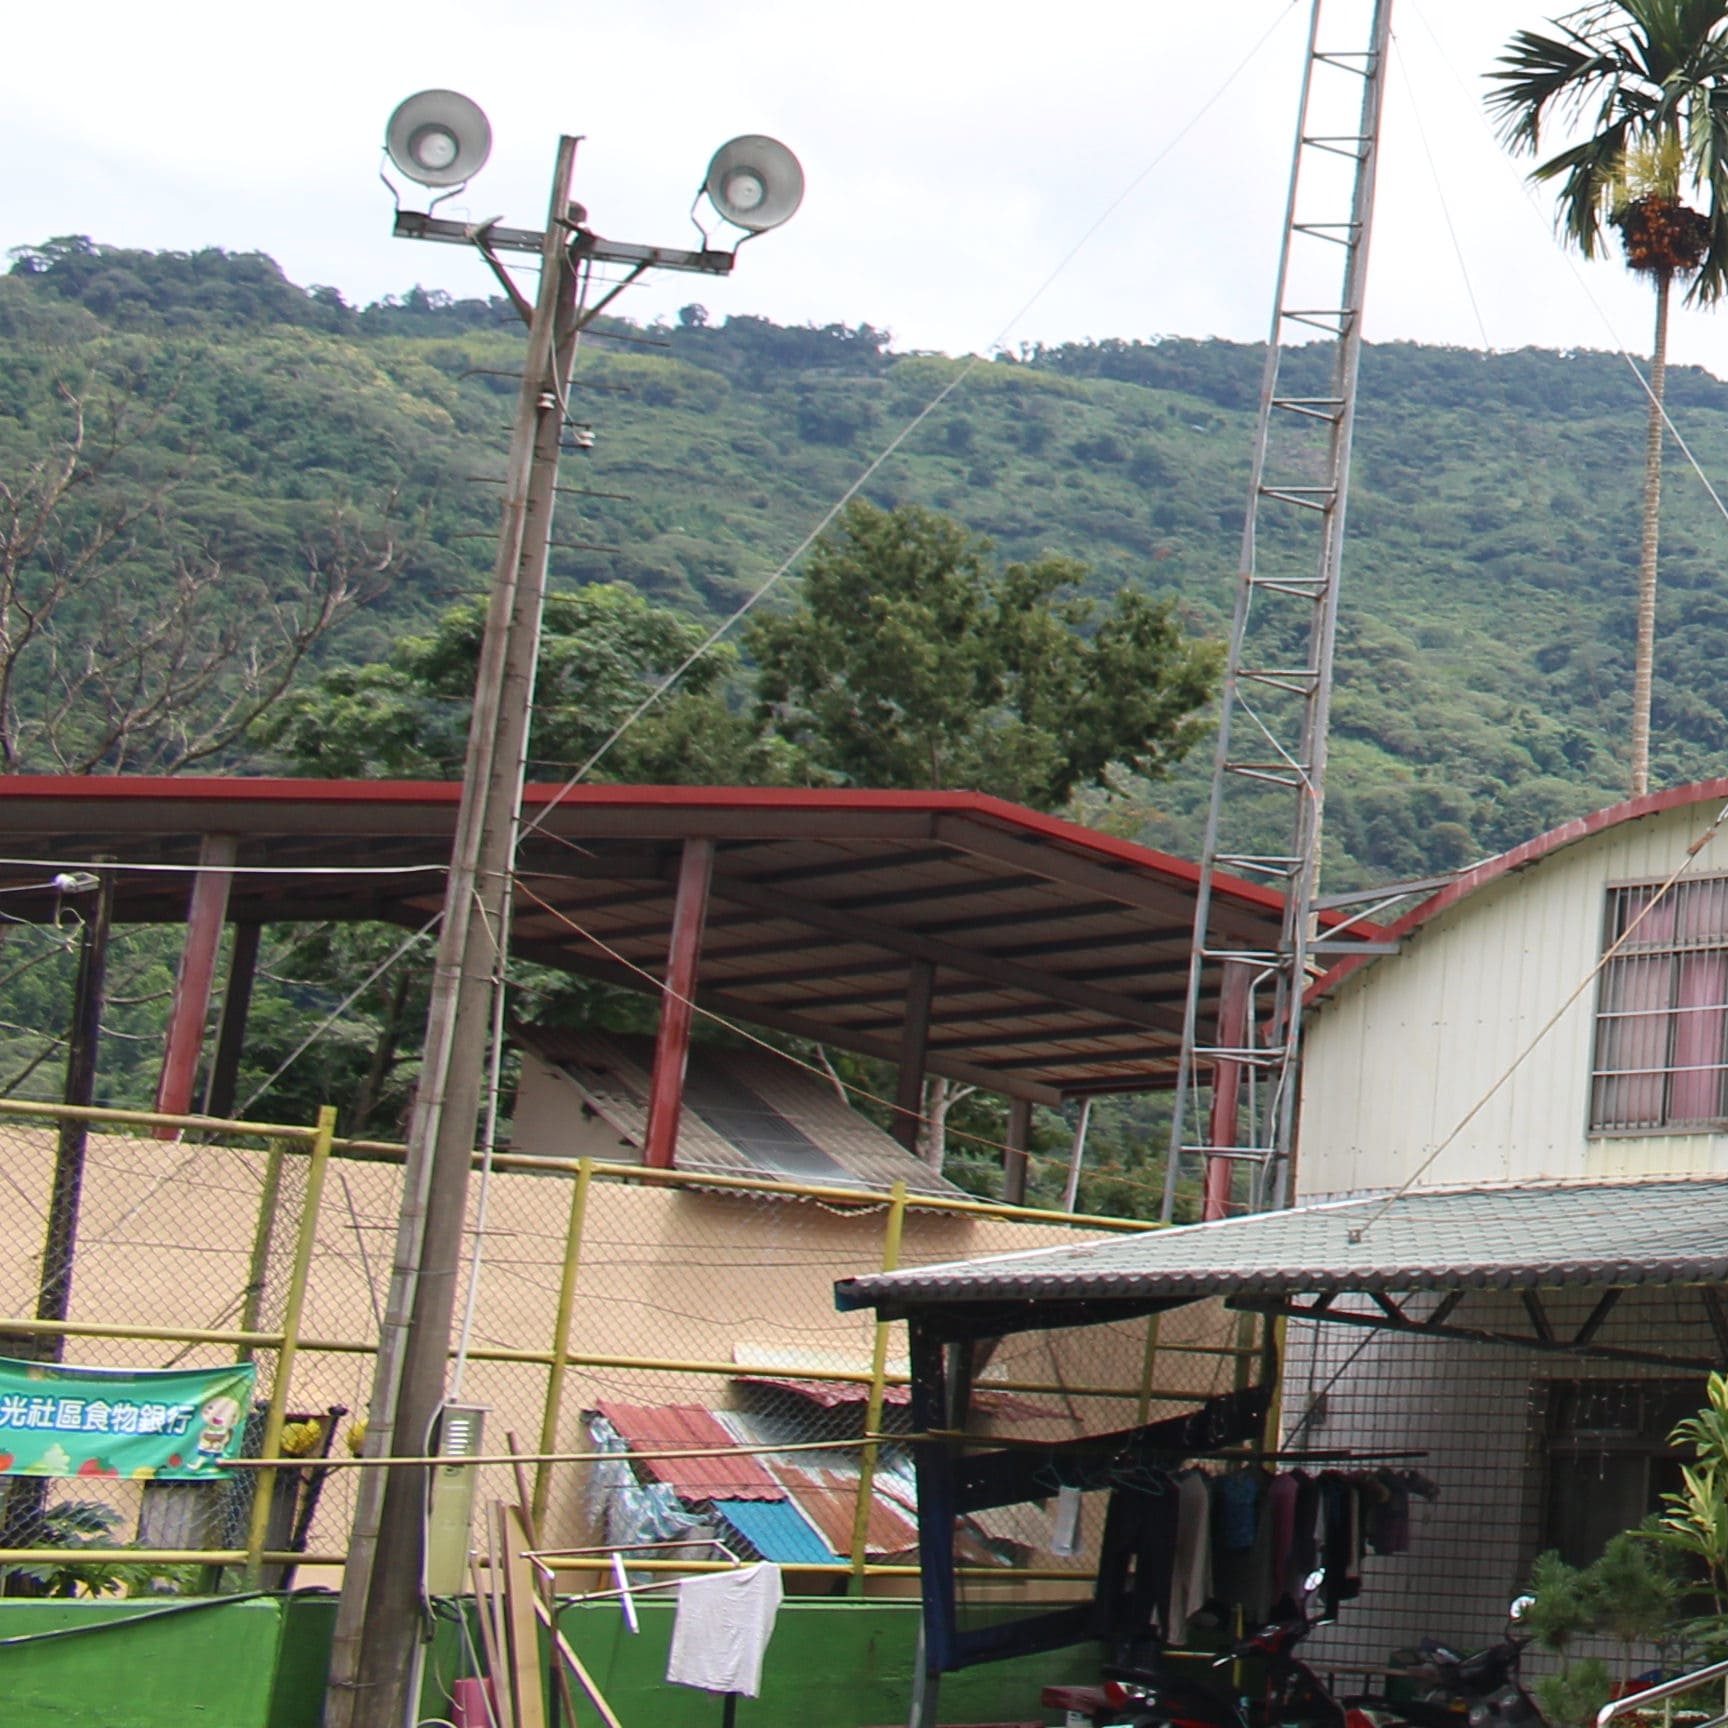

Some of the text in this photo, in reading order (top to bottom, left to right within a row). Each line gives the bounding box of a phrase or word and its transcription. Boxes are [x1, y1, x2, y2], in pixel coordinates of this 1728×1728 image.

[0, 1395, 194, 1434] 光社區食物銀行
